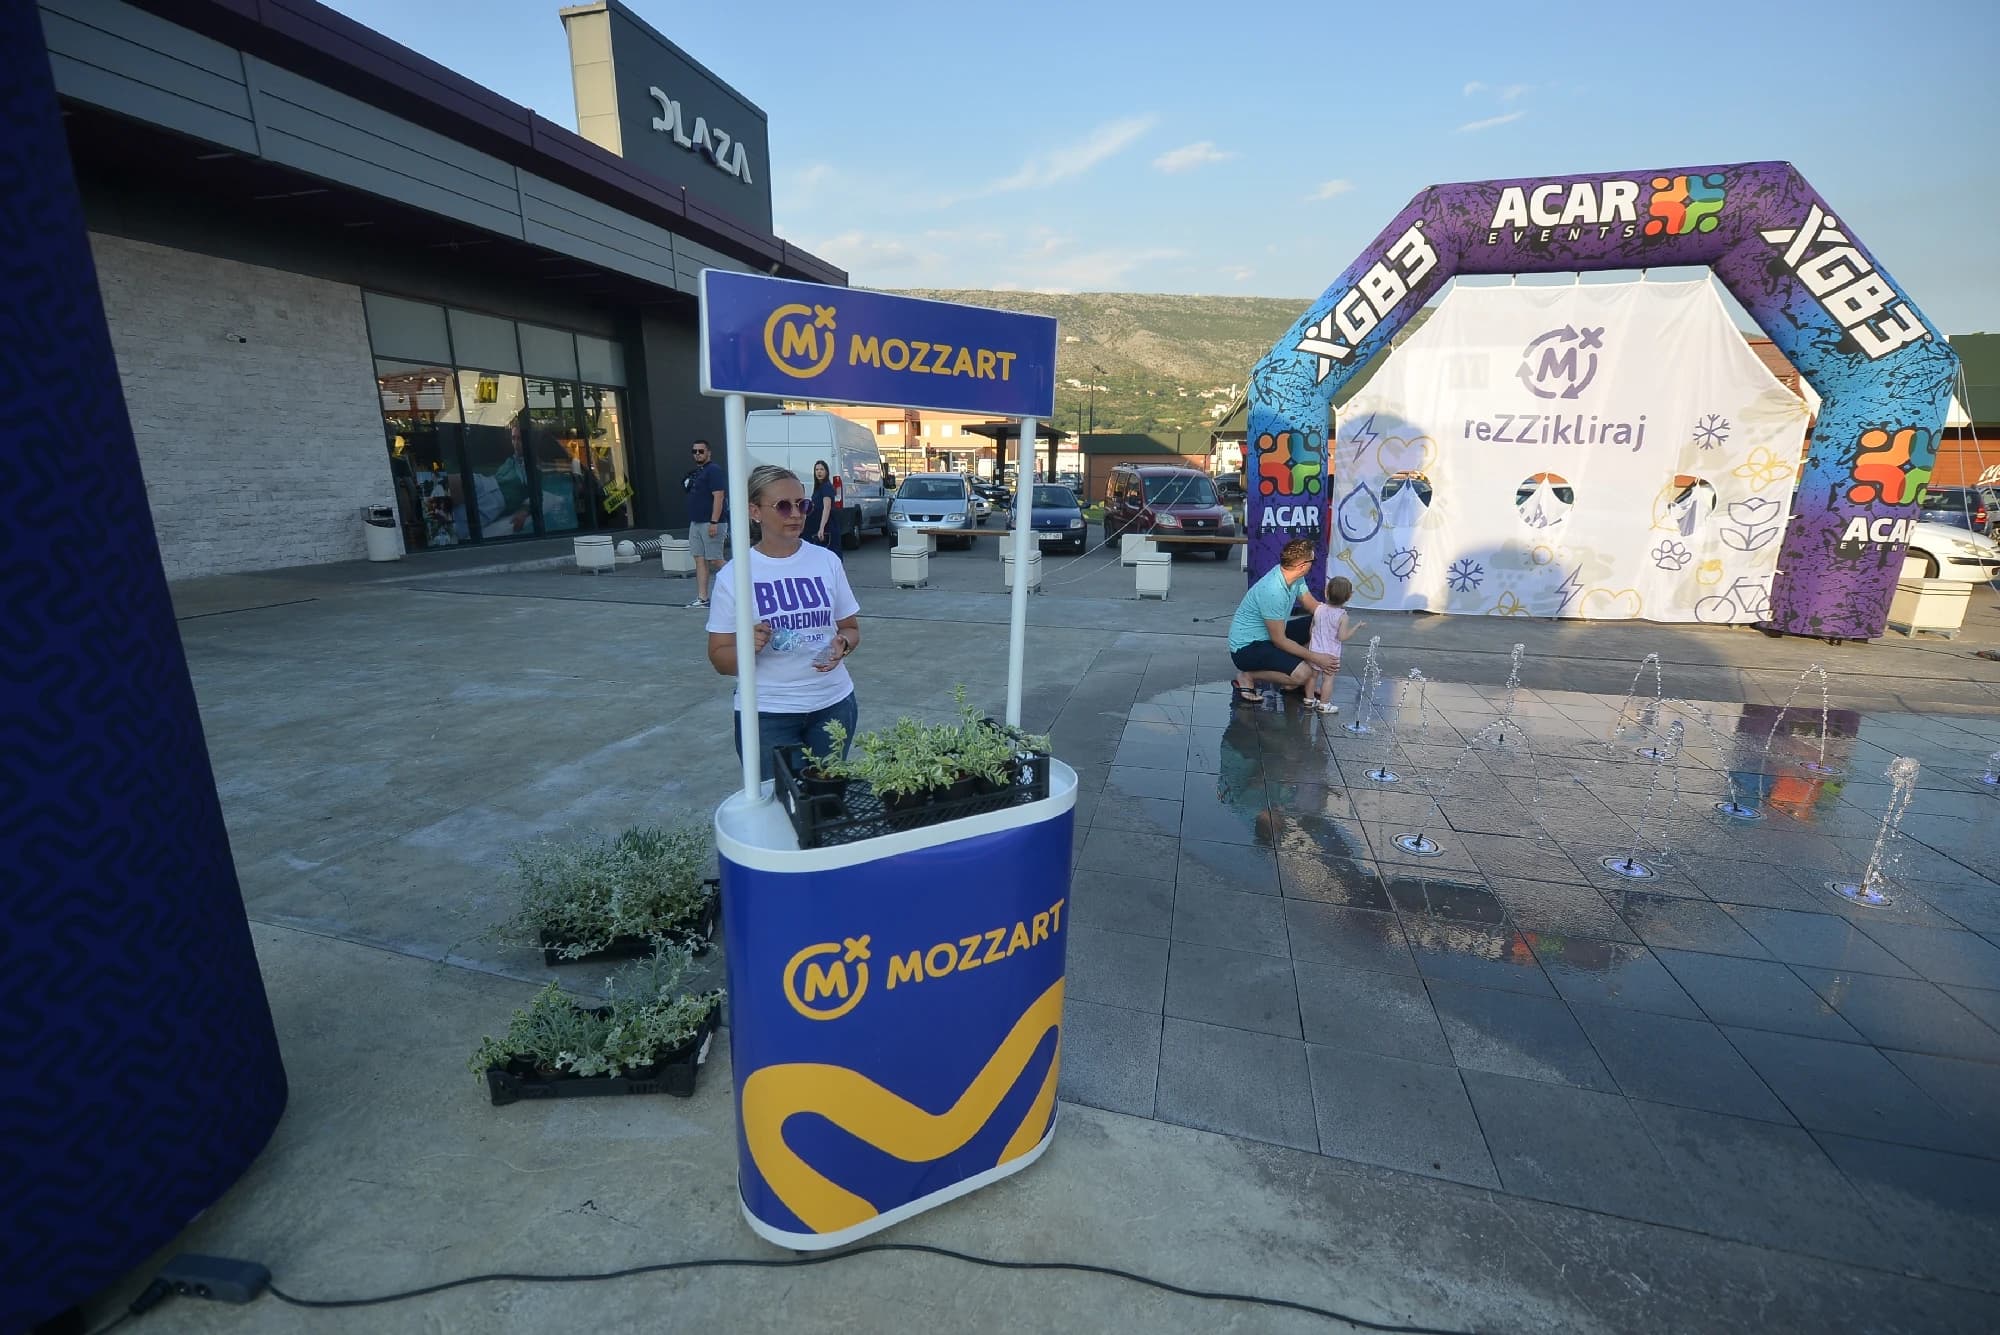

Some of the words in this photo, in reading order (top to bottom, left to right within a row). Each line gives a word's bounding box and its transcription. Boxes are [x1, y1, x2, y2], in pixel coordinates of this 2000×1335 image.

[1490, 180, 1641, 229] ACAR
[1487, 224, 1637, 245] EVENTS
[849, 334, 1017, 381] MOZZART
[1464, 414, 1647, 452] reZZikliraj
[1261, 506, 1319, 527] ACAR
[754, 577, 831, 616] BUDI
[886, 897, 1065, 990] MOZZART
